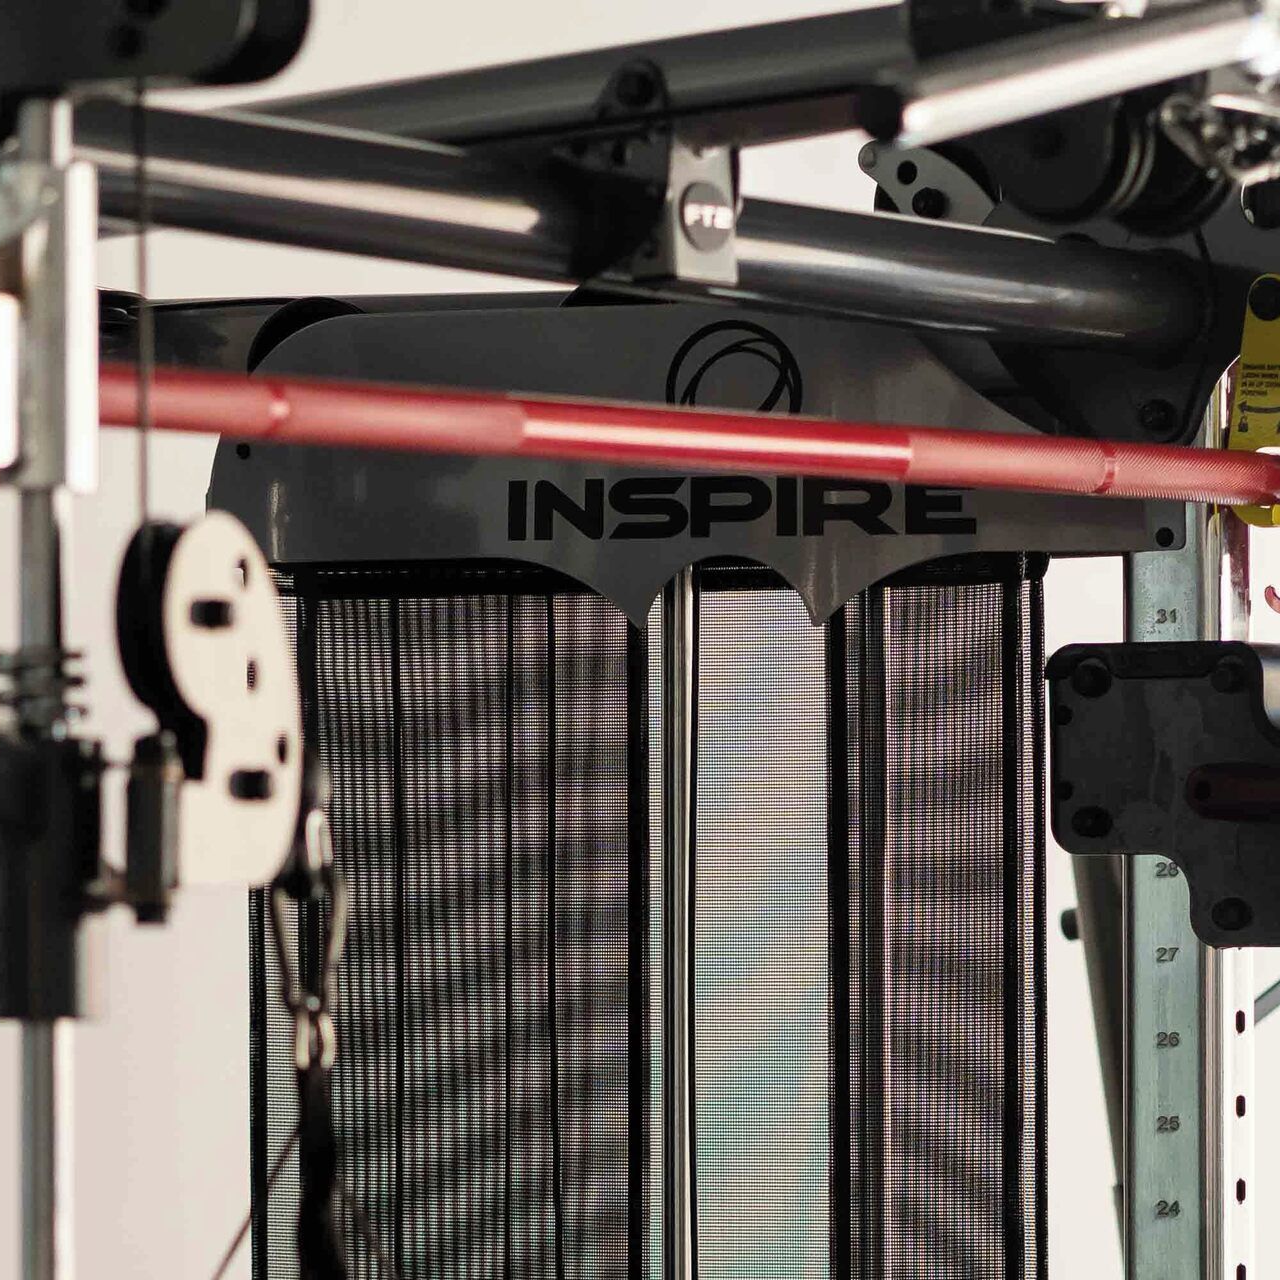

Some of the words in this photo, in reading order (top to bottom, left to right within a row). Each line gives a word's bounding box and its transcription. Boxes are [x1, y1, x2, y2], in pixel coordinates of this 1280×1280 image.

[507, 476, 977, 542] INSPIRE
[1156, 608, 1177, 624] 31
[1156, 861, 1179, 877] 28
[1156, 947, 1179, 962] 27
[1156, 1031, 1180, 1048] 26
[1156, 1115, 1180, 1132] 25
[1157, 1199, 1180, 1217] 24
